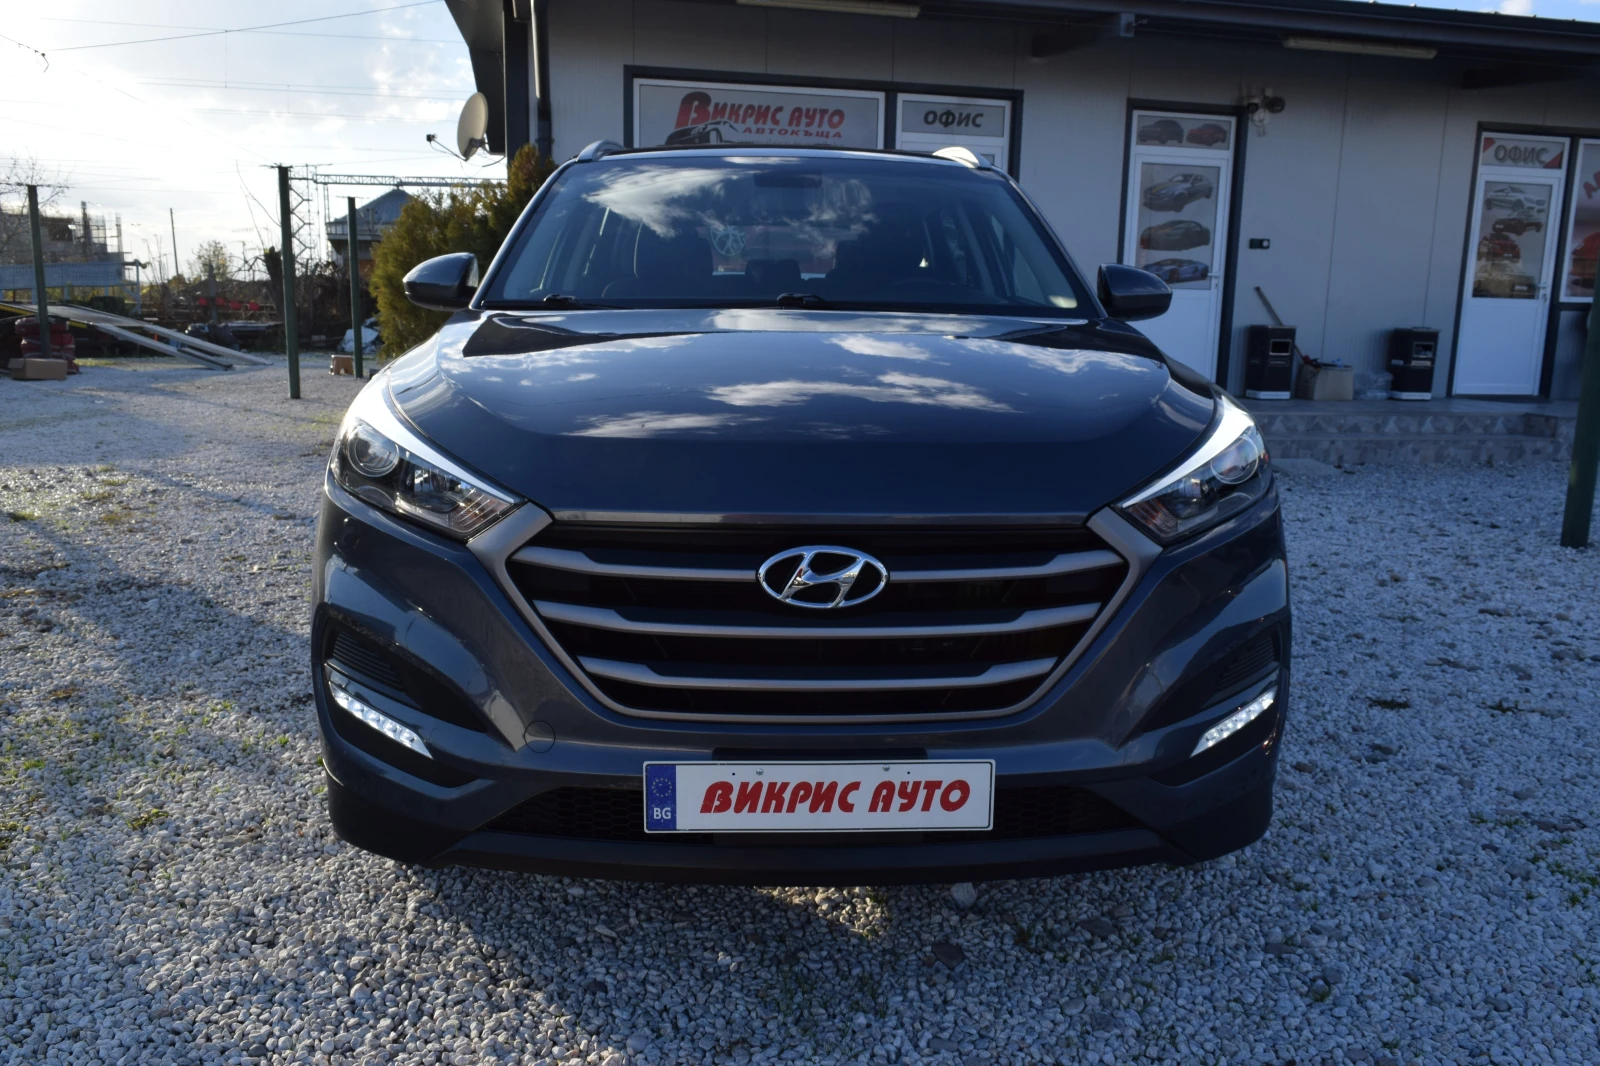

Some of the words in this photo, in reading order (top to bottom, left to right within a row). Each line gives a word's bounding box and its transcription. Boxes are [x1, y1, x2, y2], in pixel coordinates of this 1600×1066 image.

[788, 106, 845, 129] АУТО
[923, 109, 984, 128] ОФИС
[743, 127, 842, 139] АВТОКЪЩА
[1494, 144, 1549, 165] ОФИС
[700, 780, 861, 813] ВИКРИС
[868, 779, 971, 813] АУТО
[653, 807, 672, 820] BG
